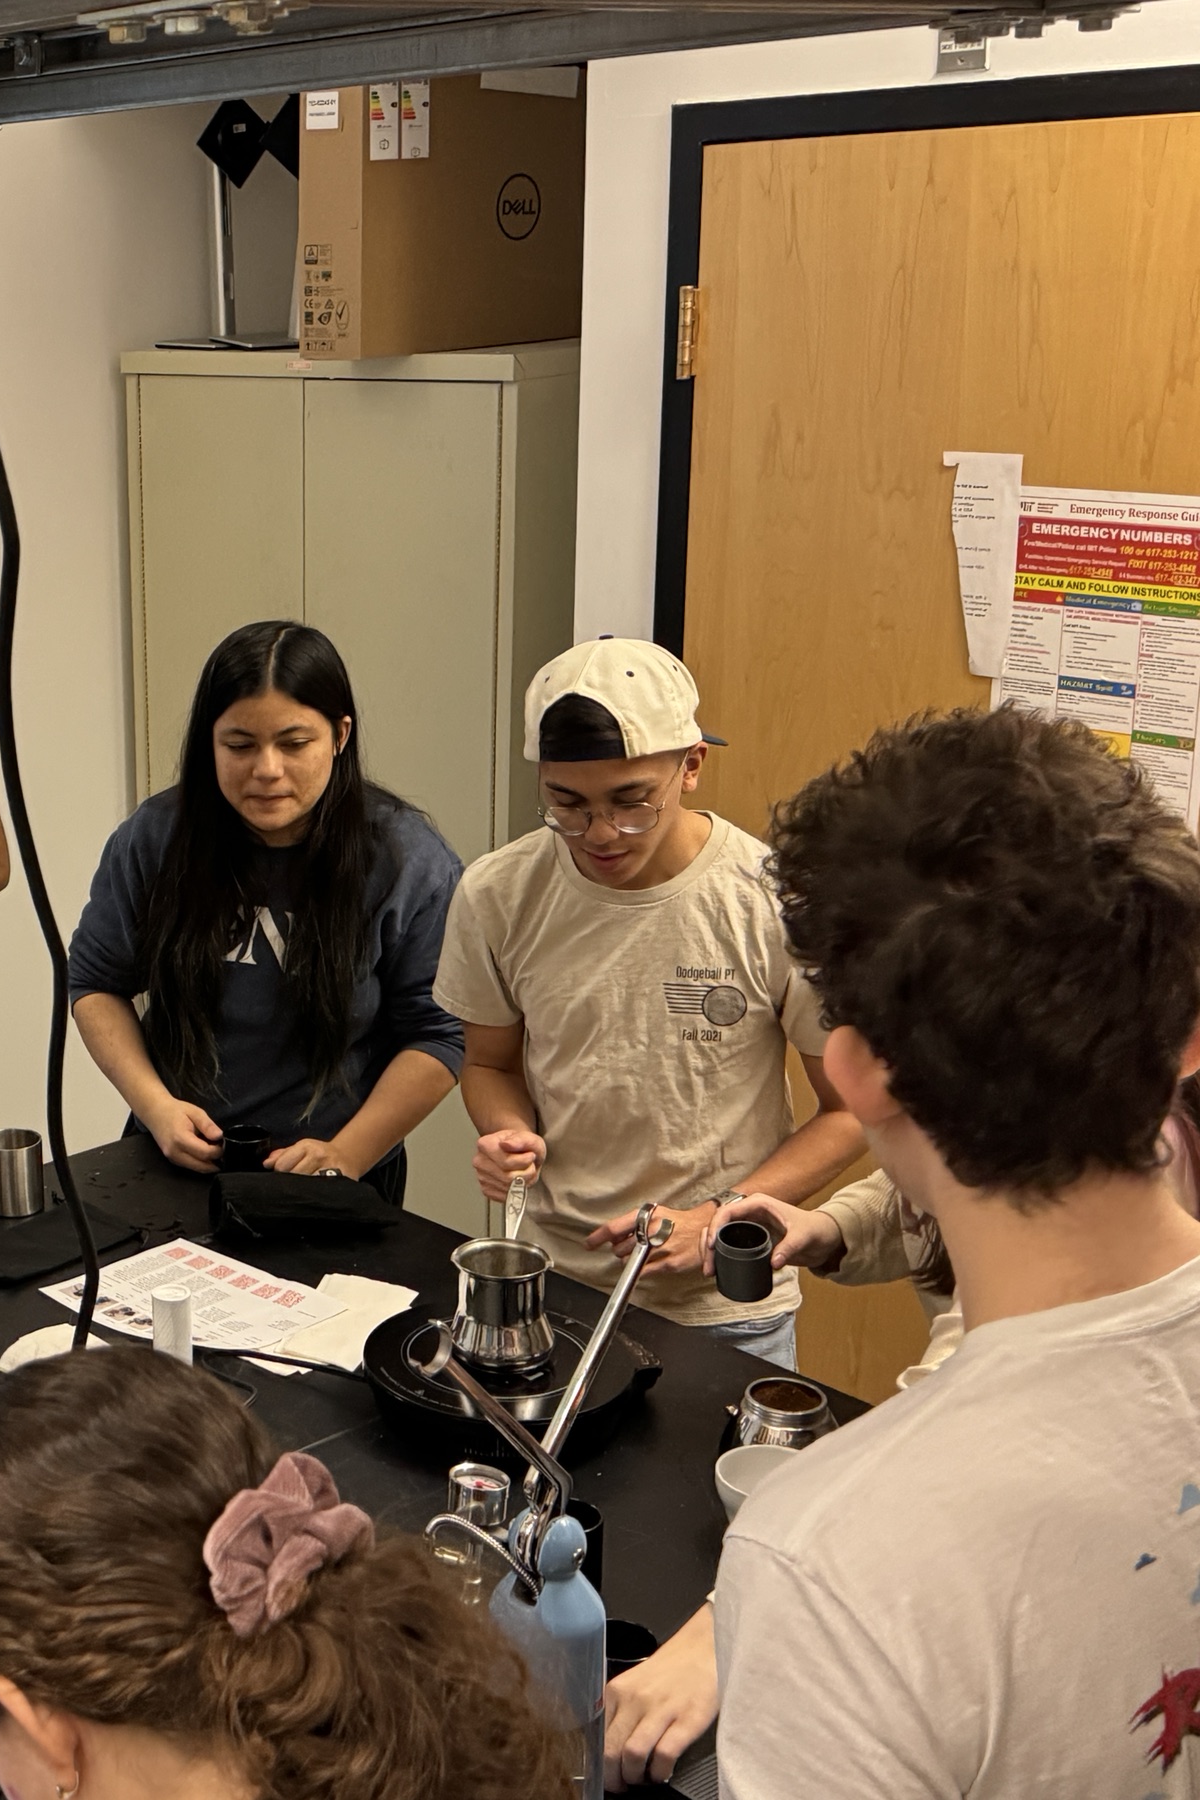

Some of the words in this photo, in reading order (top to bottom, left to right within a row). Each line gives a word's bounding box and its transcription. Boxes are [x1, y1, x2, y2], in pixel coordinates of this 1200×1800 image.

[502, 199, 536, 215] DELL
[1070, 504, 1126, 519] Emergency
[1128, 508, 1178, 522] Response
[1181, 512, 1200, 522] Gui
[1032, 522, 1120, 540] EMERGENCY
[1120, 530, 1192, 546] NUMBERS
[1120, 546, 1134, 555] 100
[1146, 548, 1198, 560] 617-253-1212
[1038, 577, 1064, 588] CALM
[1066, 580, 1086, 590] AND
[1088, 582, 1128, 595] FOLLOW
[1060, 679, 1093, 690] HAZMAT
[676, 966, 722, 981] Dodgeball
[724, 968, 736, 980] PT
[682, 1028, 698, 1040] Fall
[700, 1030, 722, 1042] 2021
